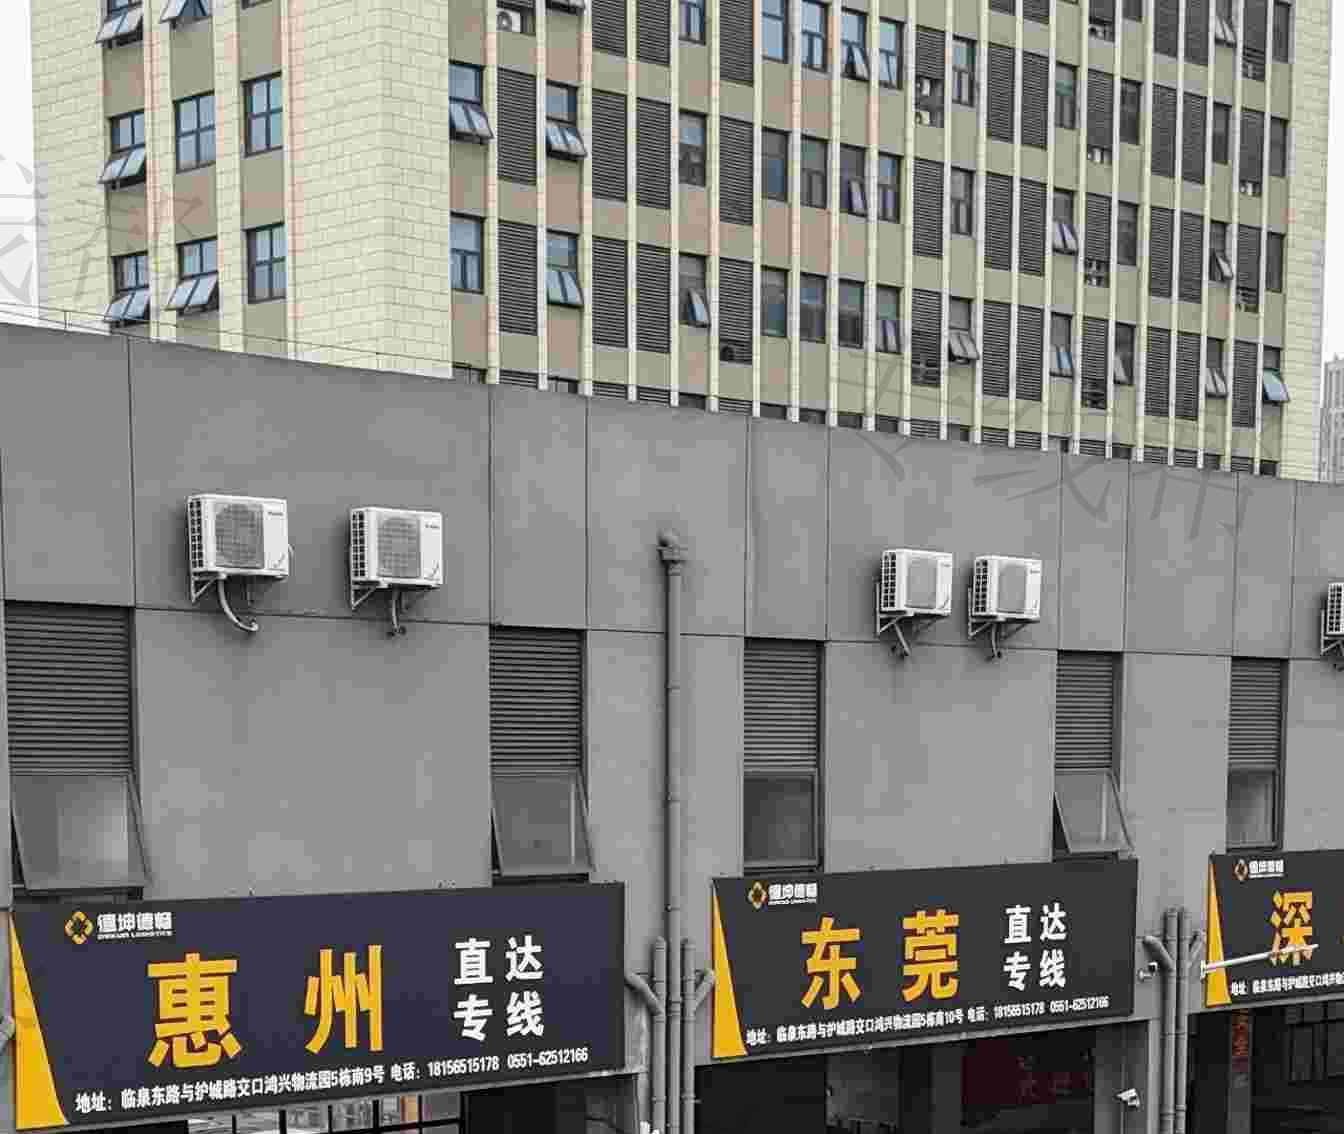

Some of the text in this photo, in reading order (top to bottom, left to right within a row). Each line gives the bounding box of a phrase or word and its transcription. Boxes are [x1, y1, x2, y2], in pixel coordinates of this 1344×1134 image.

[1004, 903, 1067, 943] 直达
[454, 934, 544, 985] 直达
[801, 909, 962, 1010] 东莞
[1003, 948, 1066, 991] 专线
[147, 945, 384, 1068] 惠州
[453, 991, 545, 1042] 专线
[506, 1047, 590, 1071] 0551-62512166
